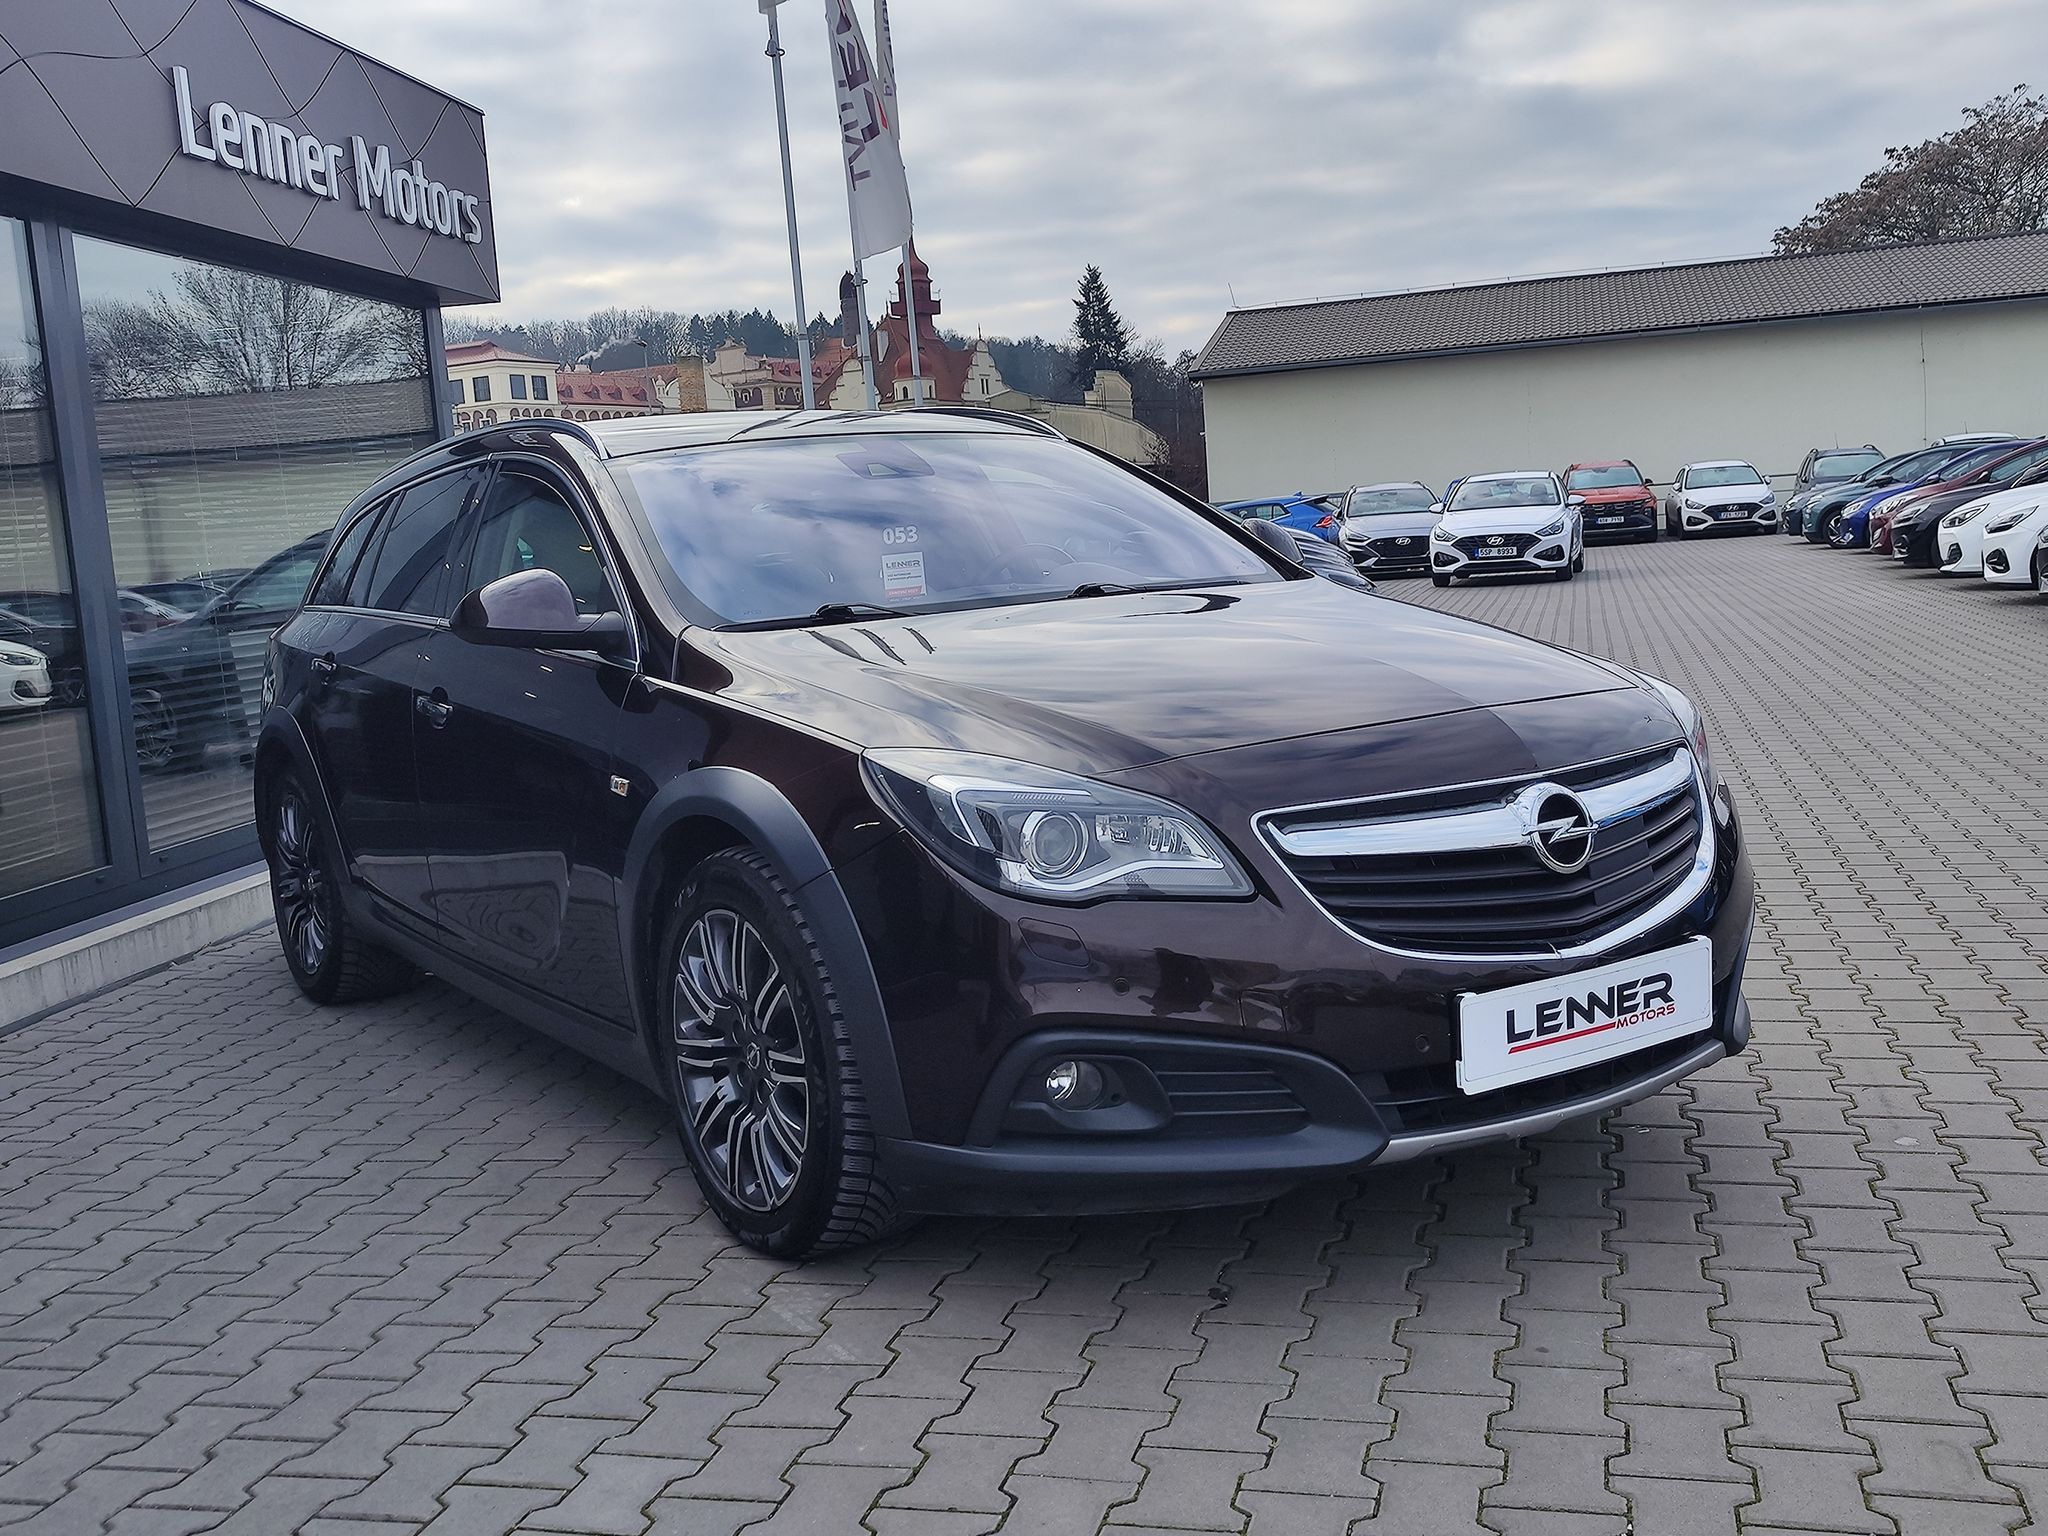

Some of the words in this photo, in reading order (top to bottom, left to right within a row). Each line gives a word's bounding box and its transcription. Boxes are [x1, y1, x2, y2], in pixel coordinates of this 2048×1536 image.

[172, 65, 344, 201] Lenner
[349, 135, 483, 245] Motors
[882, 525, 919, 545] 053
[886, 559, 921, 569] LENNER
[1506, 972, 1675, 1044] LENNER
[1615, 1003, 1676, 1030] MOTORS
